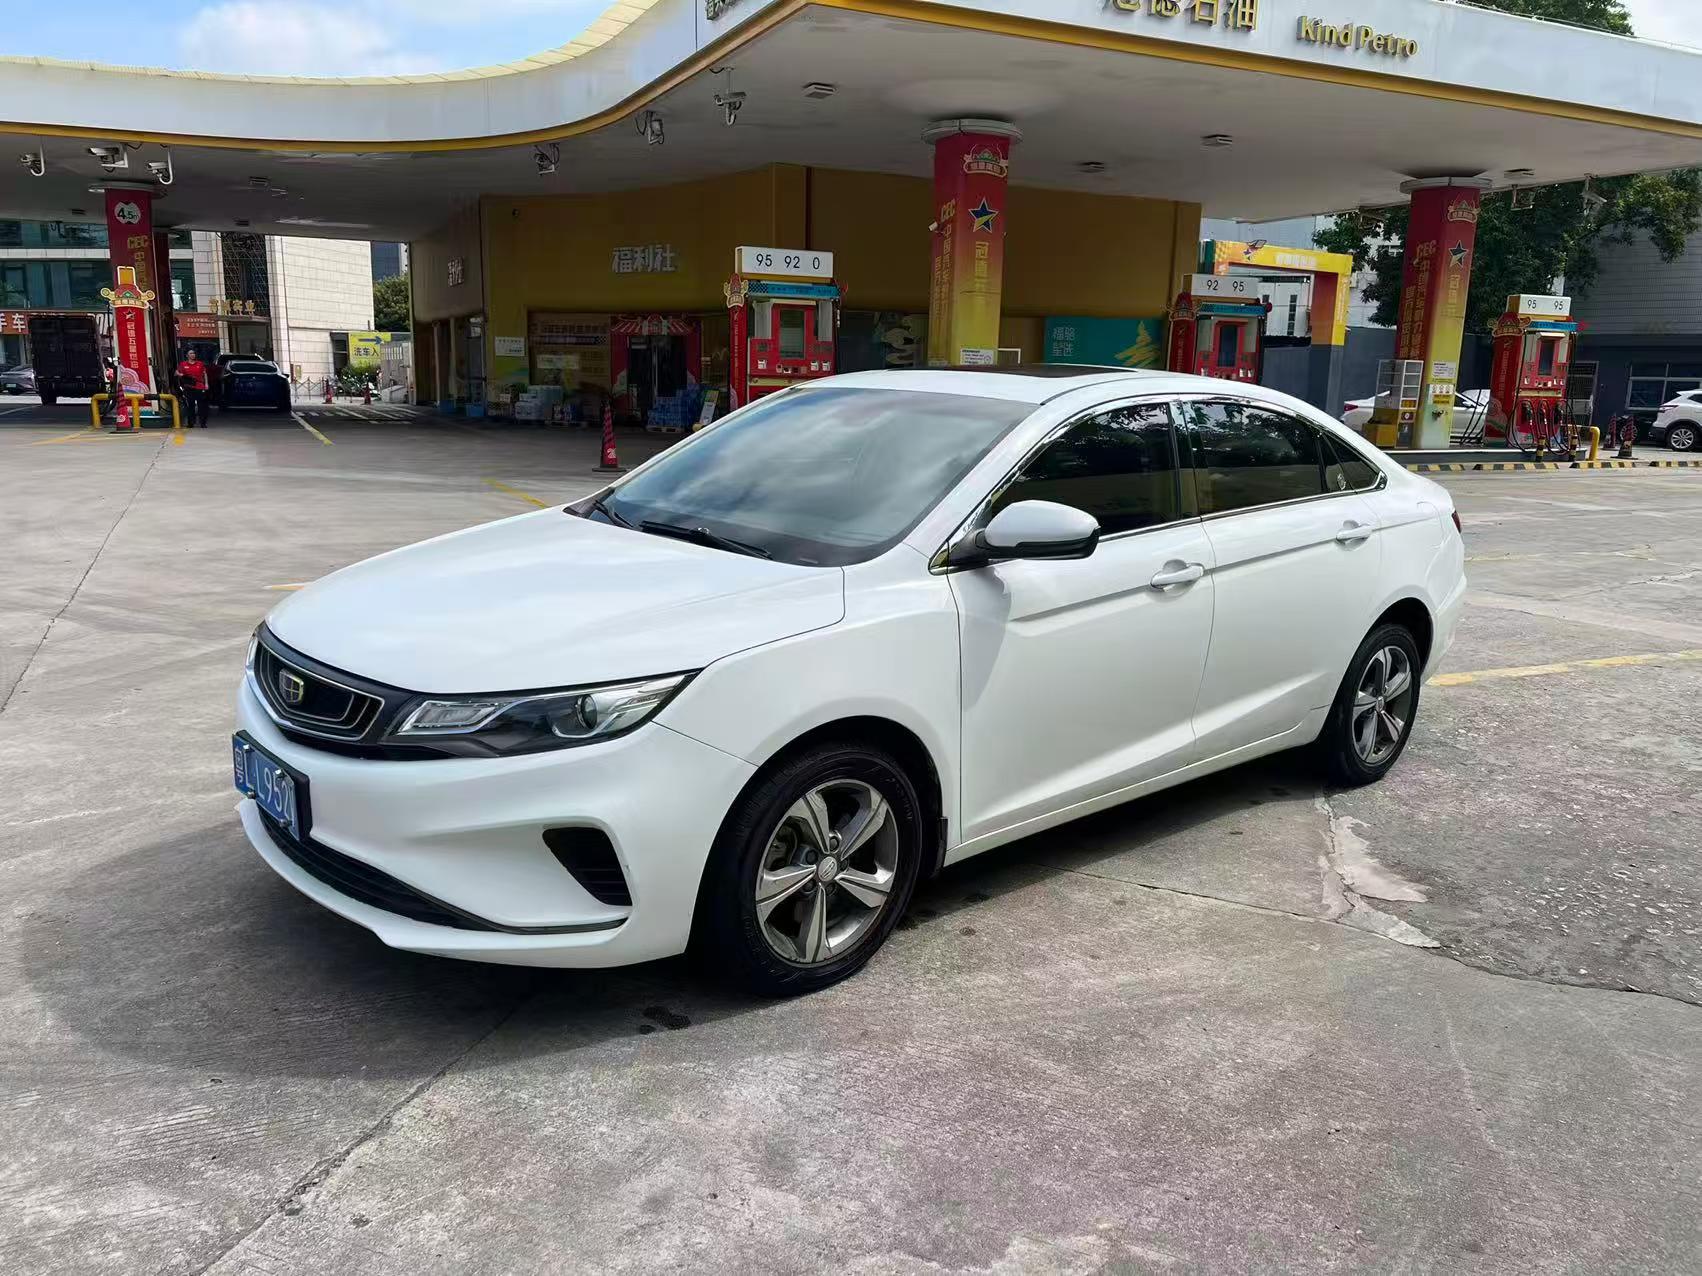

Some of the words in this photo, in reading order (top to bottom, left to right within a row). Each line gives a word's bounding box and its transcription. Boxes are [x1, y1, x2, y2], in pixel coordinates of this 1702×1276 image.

[1104, 0, 1257, 32] 石油
[1296, 15, 1354, 47] Kind
[1355, 24, 1419, 58] Petro
[612, 245, 676, 273] 福利社
[756, 253, 773, 267] 95
[784, 255, 801, 269] 92
[812, 256, 821, 270] 0
[1206, 279, 1219, 291] 92
[1232, 281, 1245, 293] 95
[1527, 299, 1537, 309] 95
[1553, 300, 1564, 311] 95
